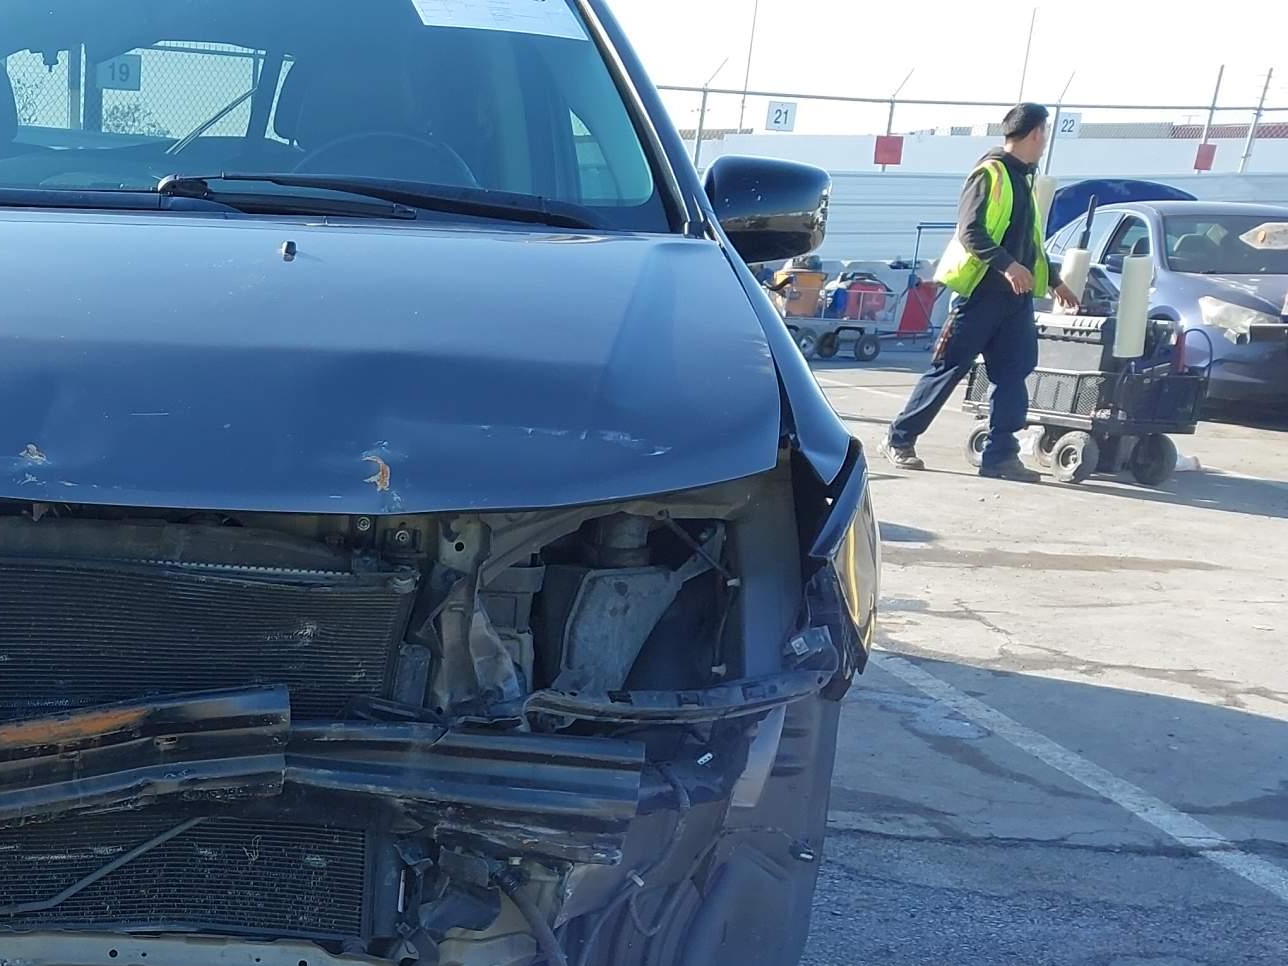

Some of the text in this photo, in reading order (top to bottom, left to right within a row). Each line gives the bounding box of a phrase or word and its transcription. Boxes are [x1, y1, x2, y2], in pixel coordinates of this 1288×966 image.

[108, 63, 130, 82] 19
[774, 109, 789, 124] 21
[1061, 119, 1075, 132] 22
